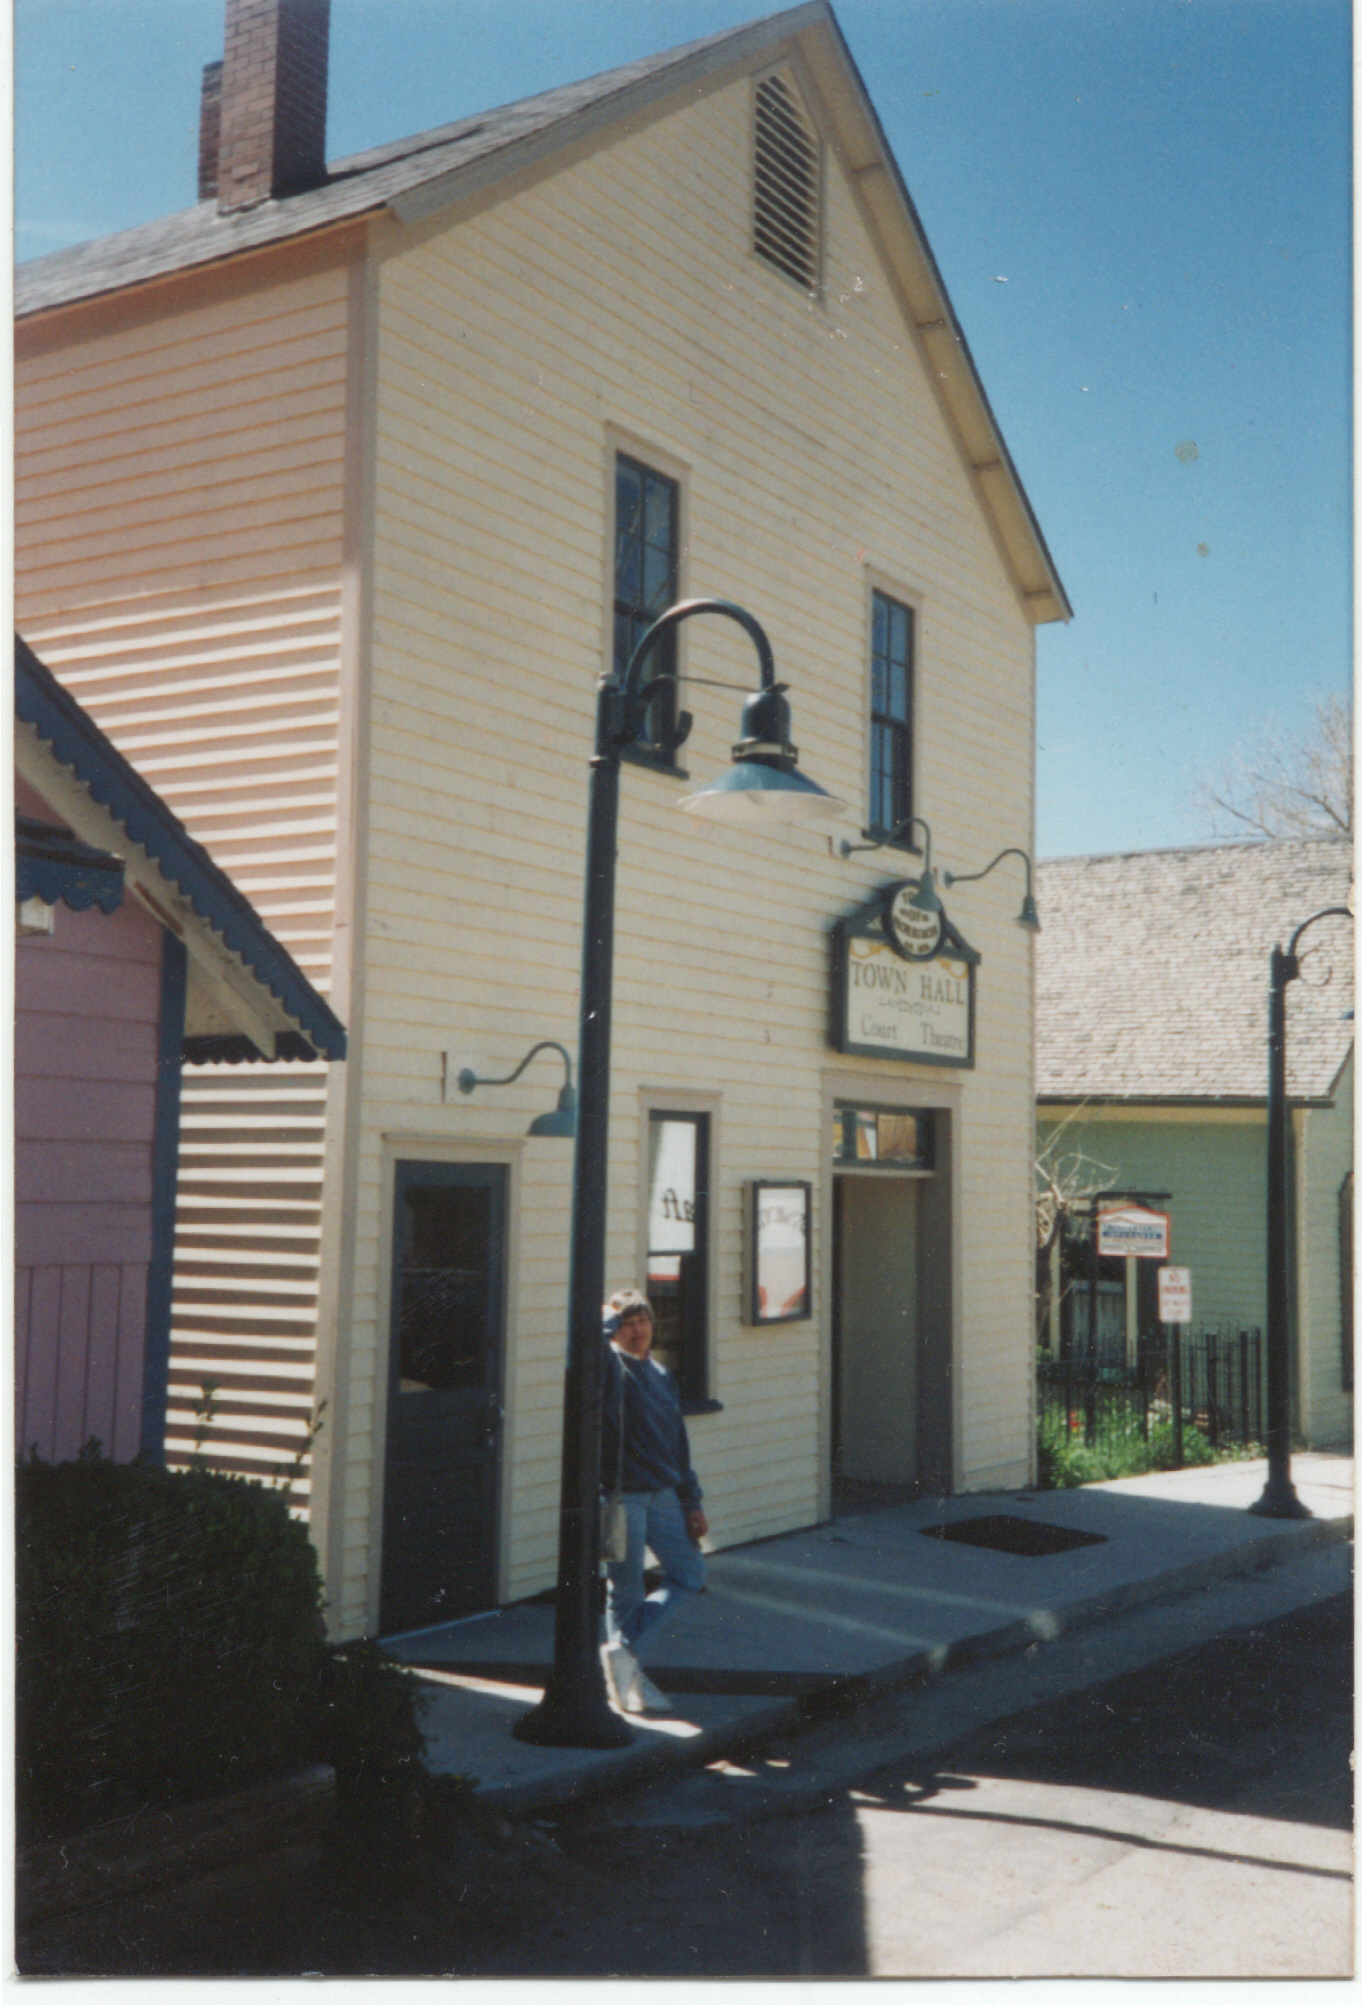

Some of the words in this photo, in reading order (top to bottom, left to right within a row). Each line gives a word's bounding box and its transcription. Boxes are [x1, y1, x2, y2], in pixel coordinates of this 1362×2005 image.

[852, 961, 907, 995] TOWN
[920, 975, 964, 1005] HALL
[861, 1014, 897, 1040] Court
[920, 1022, 964, 1050] Theatre
